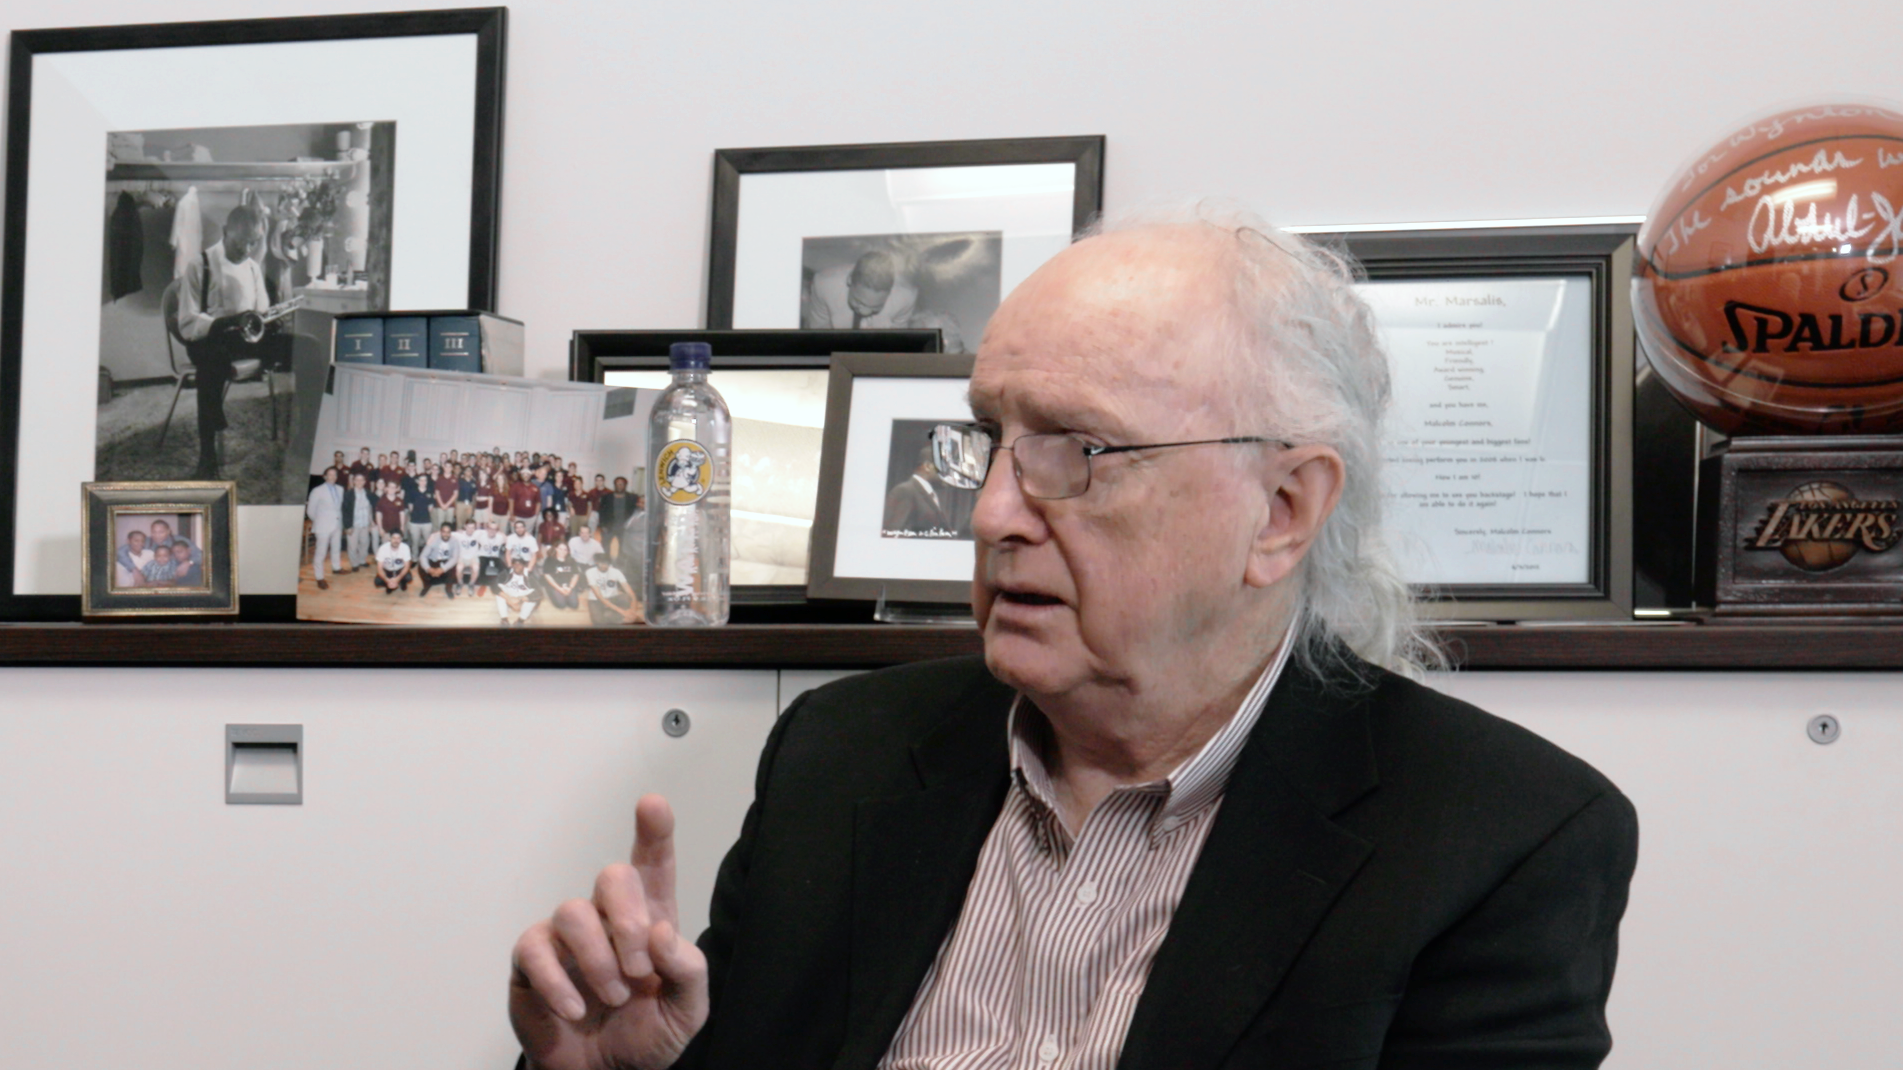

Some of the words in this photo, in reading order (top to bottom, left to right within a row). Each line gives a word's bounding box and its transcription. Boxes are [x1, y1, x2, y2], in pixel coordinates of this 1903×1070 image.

[1415, 297, 1439, 307] Mr.
[1445, 294, 1507, 308] Marsalis,
[355, 338, 361, 350] I
[399, 338, 411, 350] II
[445, 337, 464, 349] III
[1444, 402, 1456, 410] you
[1424, 419, 1456, 427] Malcolm
[1439, 438, 1469, 448] youngest
[1471, 438, 1485, 446] and
[1486, 438, 1512, 448] biggest
[1425, 456, 1454, 465] perform
[1455, 457, 1468, 465] you
[1499, 455, 1517, 463] when
[659, 449, 674, 485] LENWICH
[1435, 473, 1451, 481] Now
[1400, 491, 1428, 500] allowing
[1465, 492, 1478, 500] you
[1480, 490, 1516, 500] backstage!
[1529, 490, 1546, 499] hope
[1548, 490, 1562, 498] that
[1431, 500, 1446, 508] able
[1755, 502, 1898, 551] LAKERS
